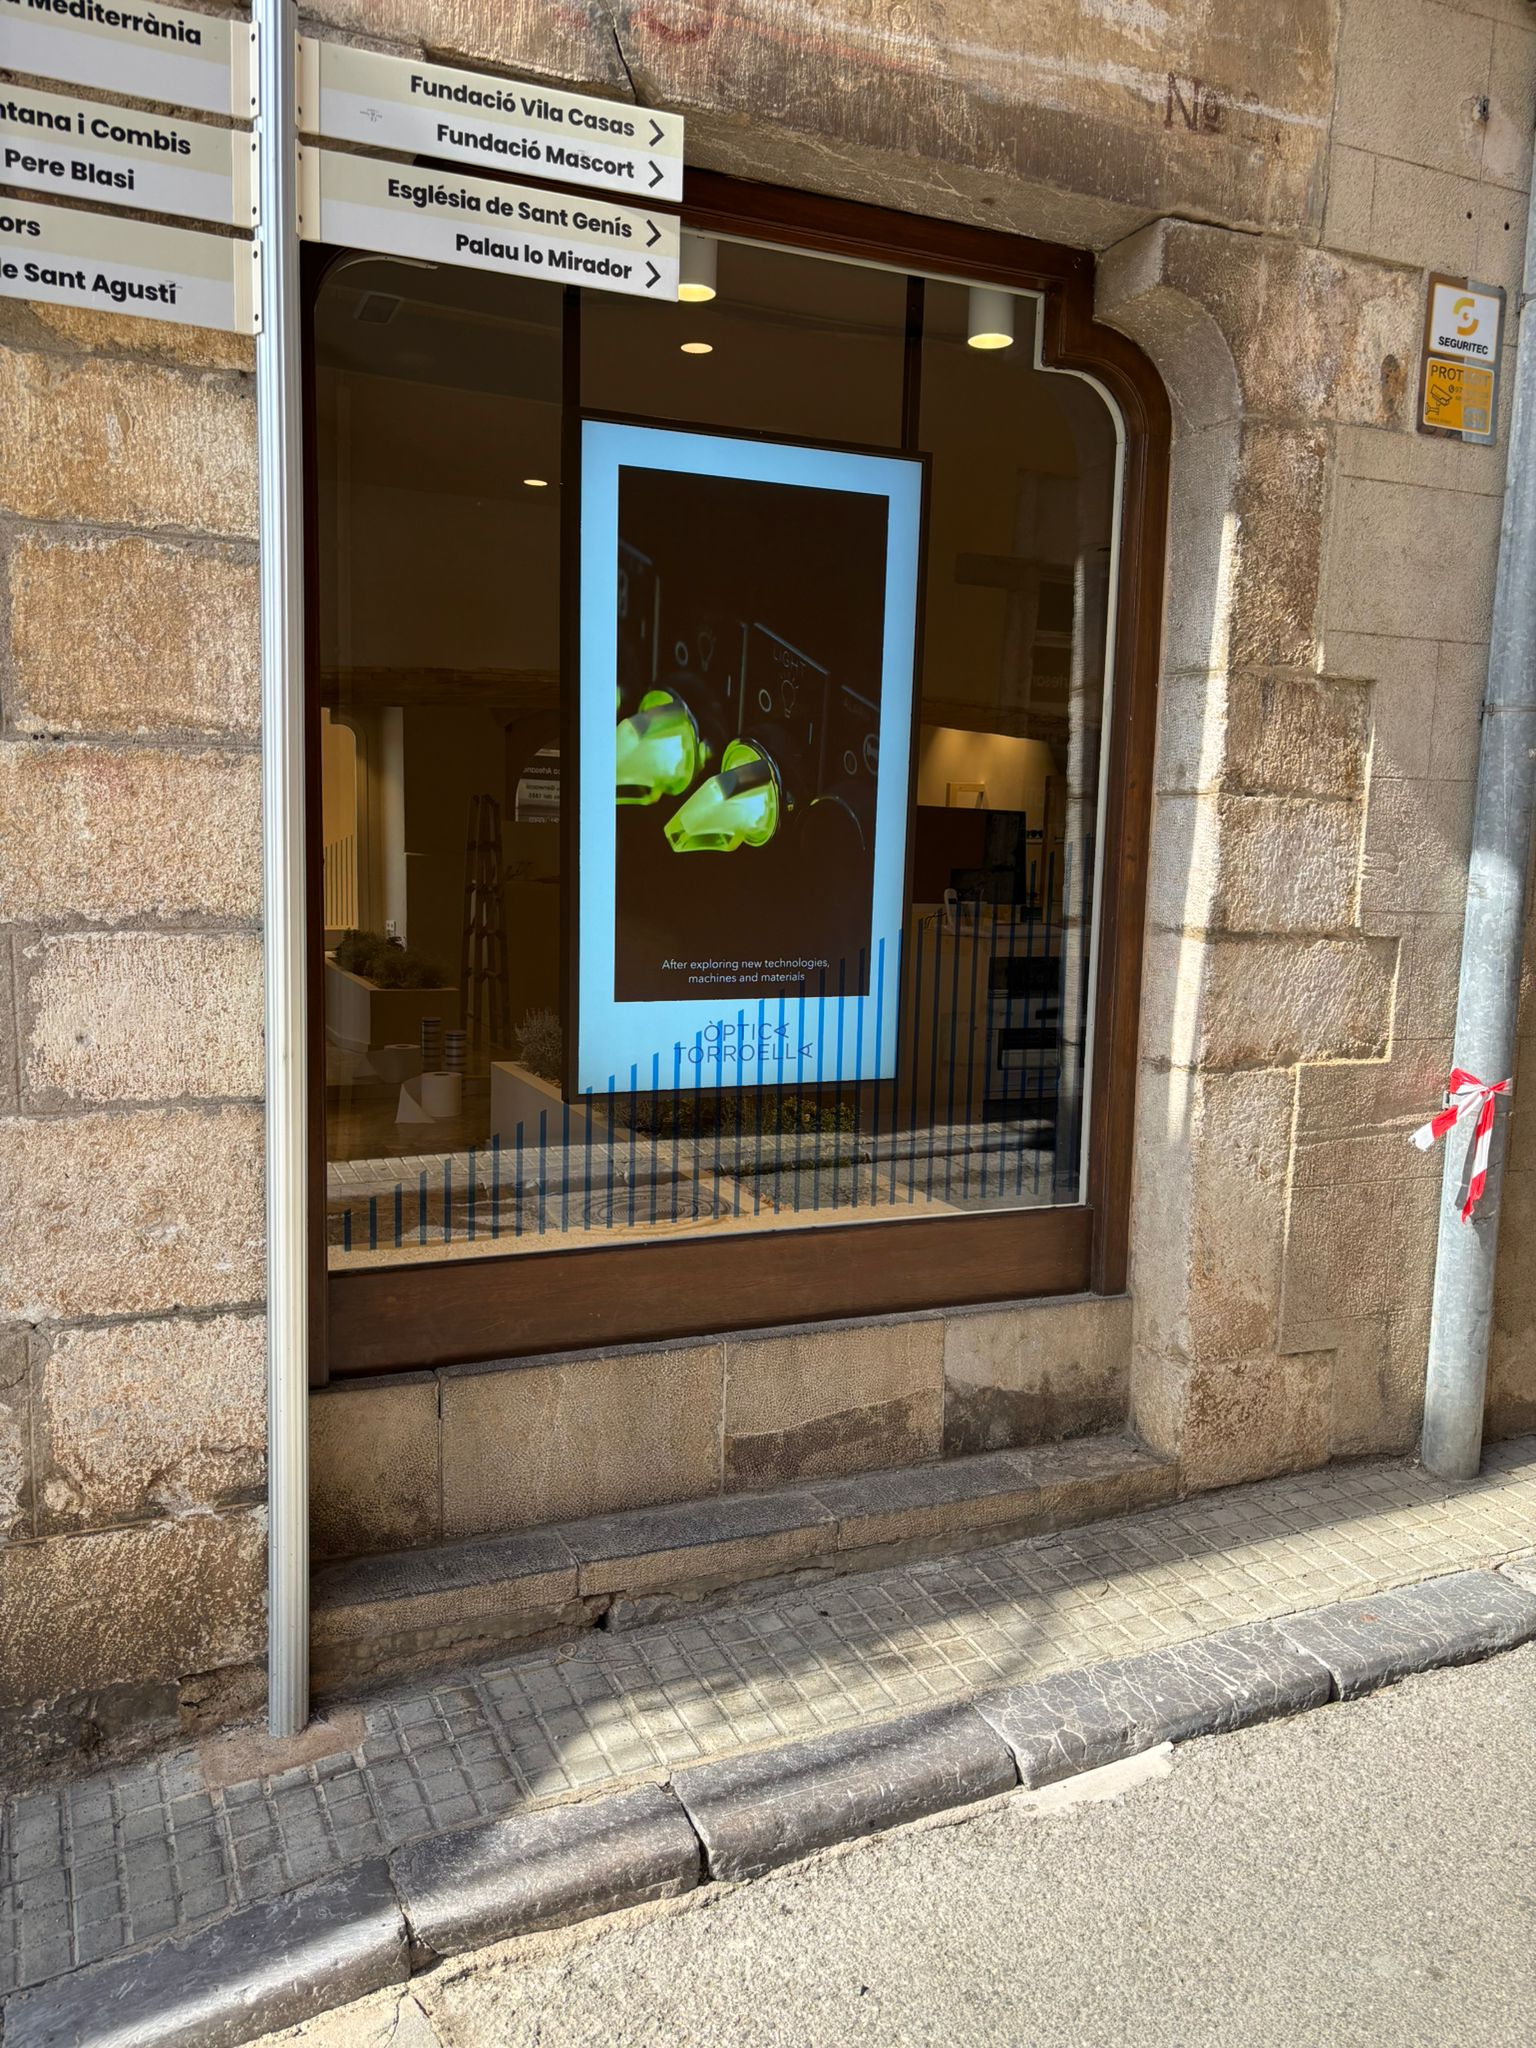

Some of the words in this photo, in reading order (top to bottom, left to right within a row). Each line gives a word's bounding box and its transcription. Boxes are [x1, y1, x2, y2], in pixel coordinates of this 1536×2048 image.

[411, 75, 516, 112] Fundació
[521, 98, 563, 122] Vila
[568, 108, 635, 137] Casas
[78, 113, 84, 135] i
[91, 119, 191, 155] Combis
[437, 124, 541, 161] Fundació
[546, 146, 635, 179] Mascort
[5, 148, 65, 177] Pere
[71, 161, 135, 190] Blasi
[388, 179, 481, 208] Església
[486, 198, 513, 217] de
[518, 202, 568, 227] Sant
[573, 212, 633, 239] Genís
[456, 234, 518, 262] Palau
[524, 243, 543, 264] lo
[548, 250, 632, 279] Mirador
[24, 262, 86, 290] Sant
[92, 274, 176, 304] Agustí
[1438, 336, 1489, 355] SEGURITEC
[662, 959, 687, 970] After
[690, 959, 739, 971] exploring
[741, 961, 762, 969] new
[764, 957, 830, 969] technologies,
[688, 974, 737, 984] machines
[739, 973, 758, 983] and
[761, 971, 805, 982] materials
[703, 1020, 790, 1042] ÒPTICA
[673, 1042, 813, 1064] TORROELLA
